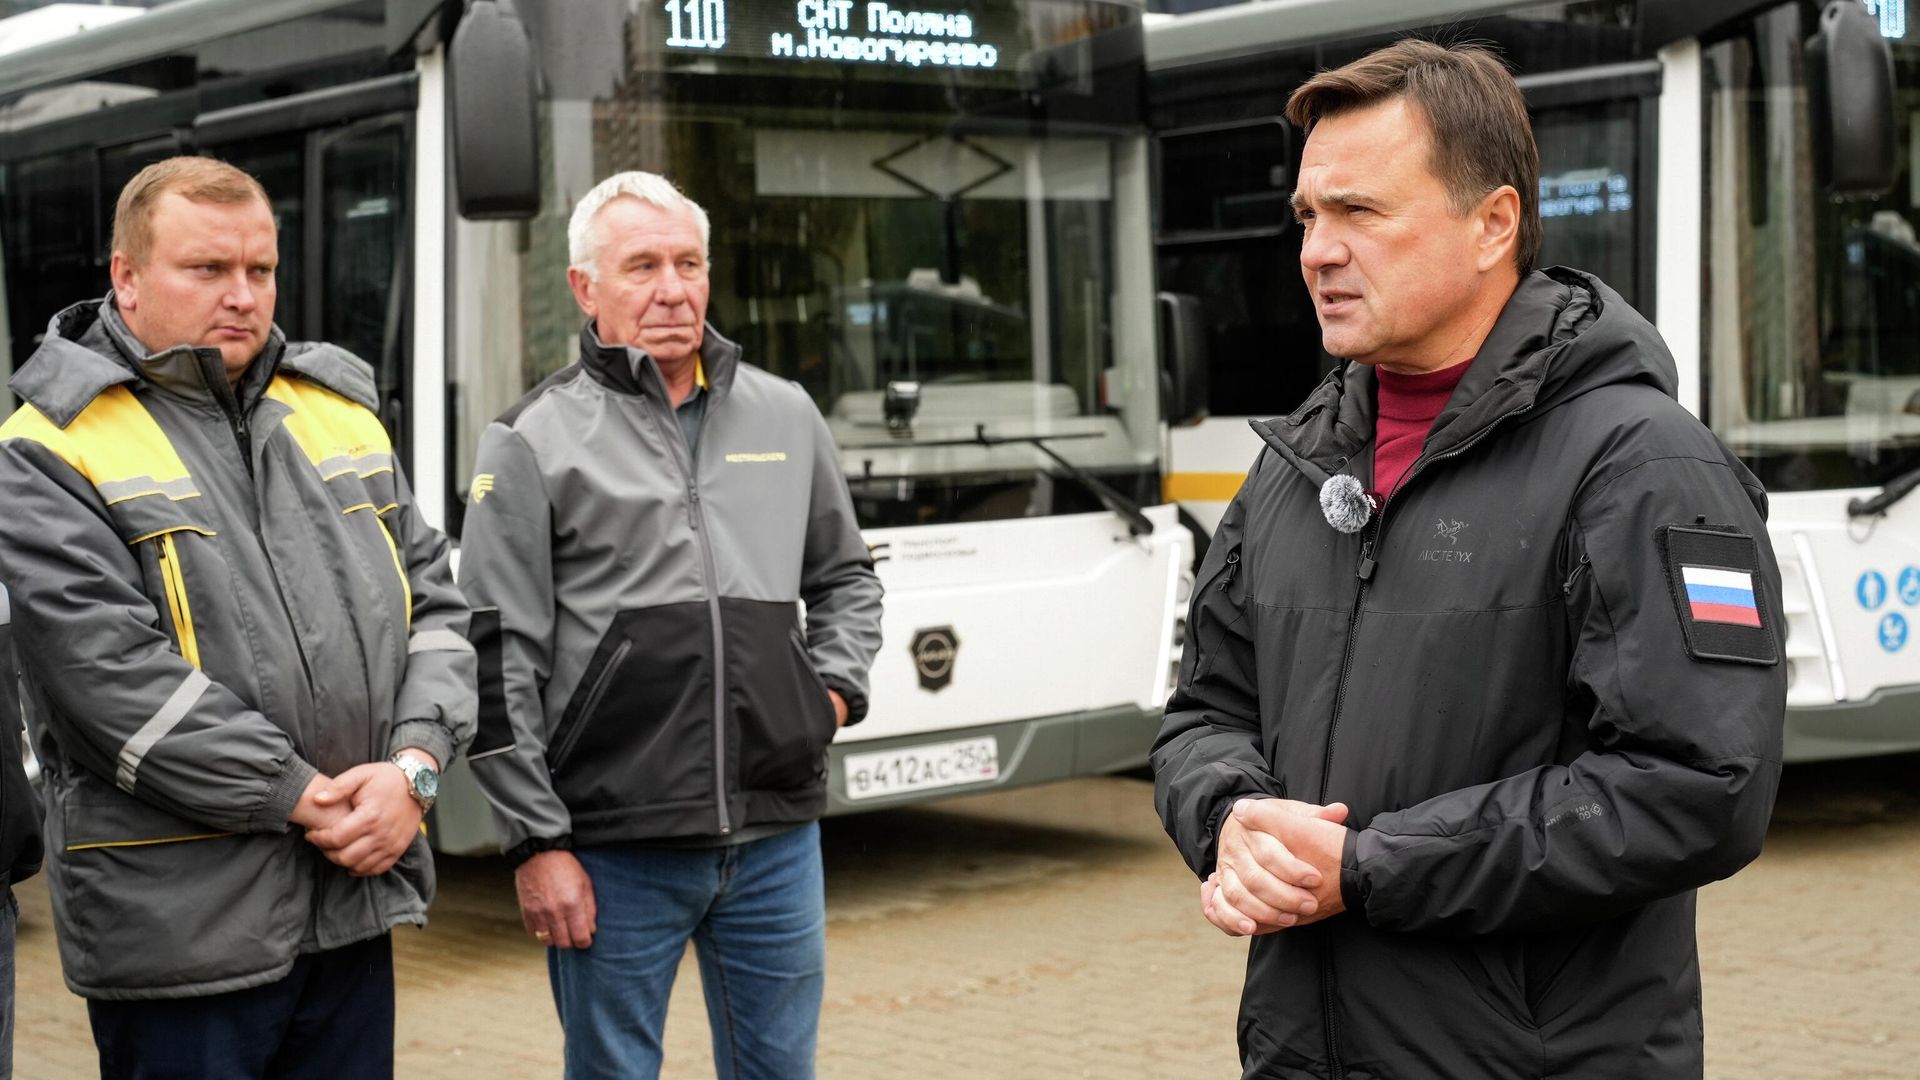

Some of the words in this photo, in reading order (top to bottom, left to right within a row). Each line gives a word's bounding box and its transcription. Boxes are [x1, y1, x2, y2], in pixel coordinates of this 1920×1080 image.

[665, 0, 725, 48] 110
[797, 0, 853, 30] СНТ
[867, 2, 972, 38] Поляна
